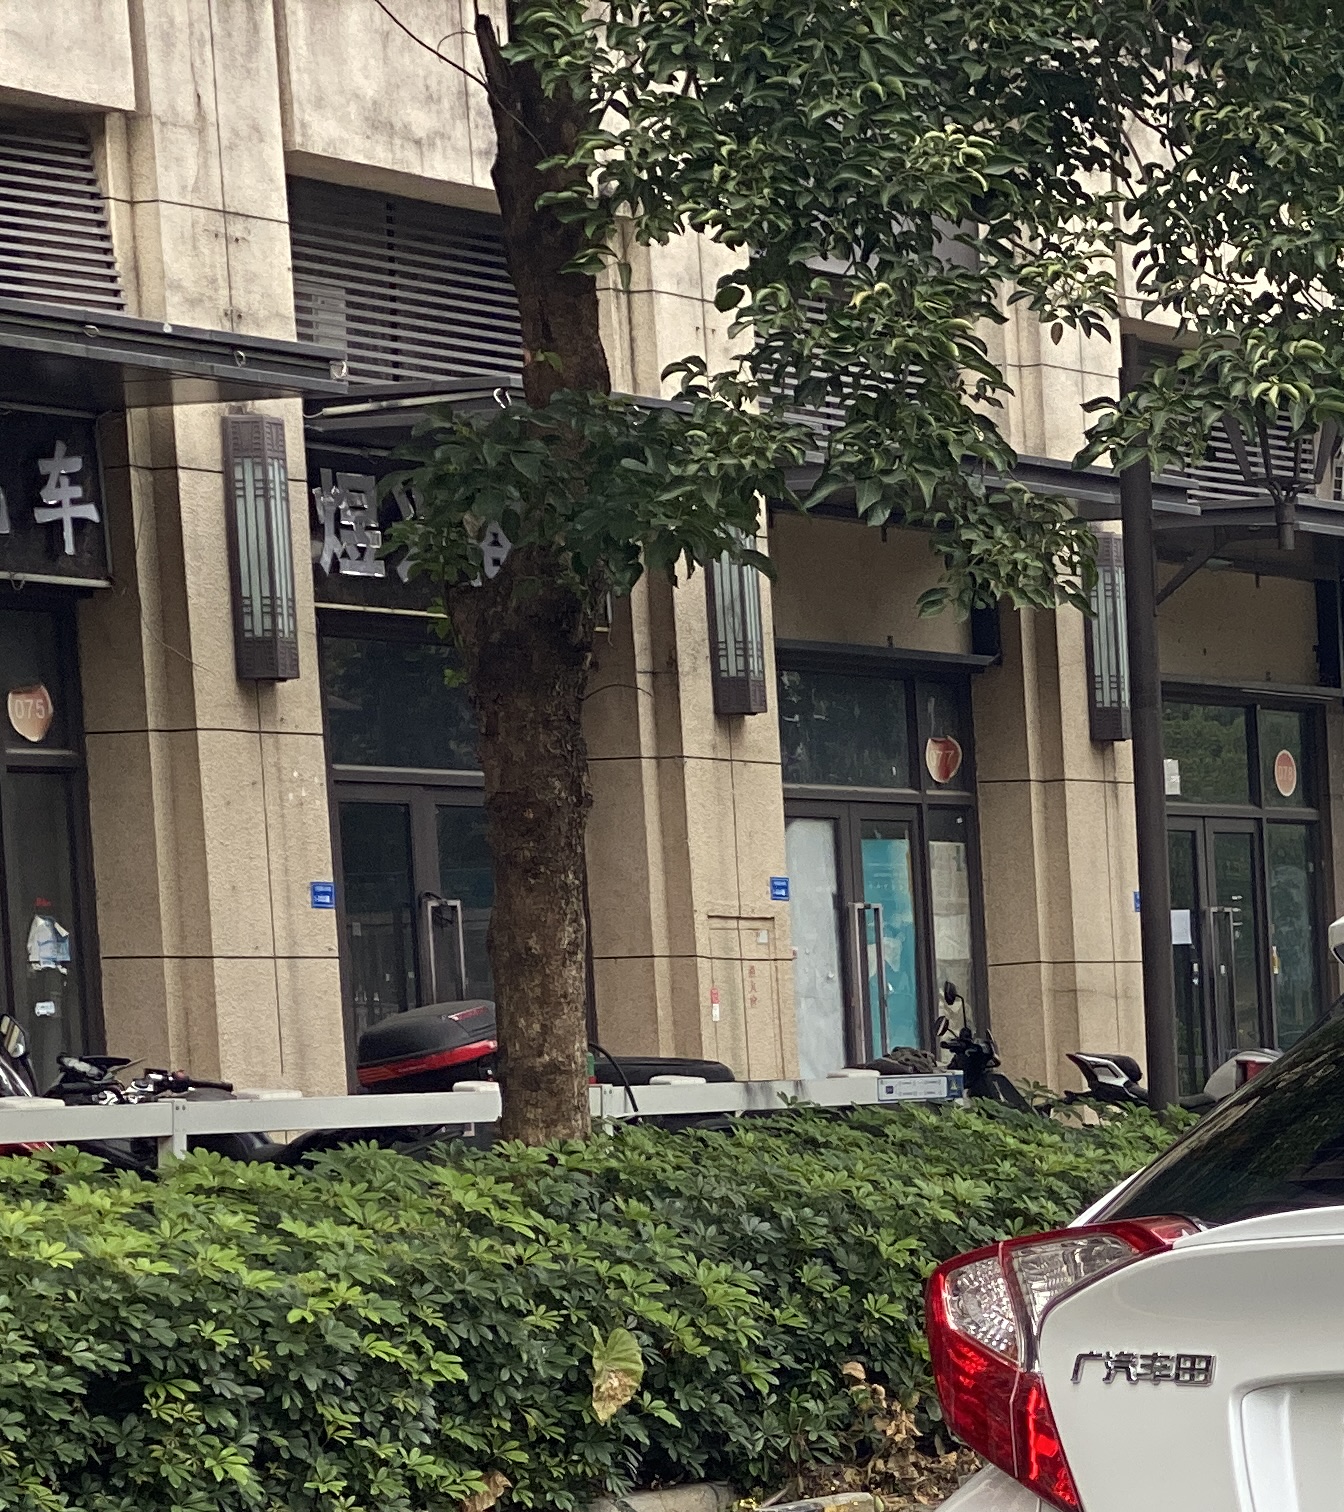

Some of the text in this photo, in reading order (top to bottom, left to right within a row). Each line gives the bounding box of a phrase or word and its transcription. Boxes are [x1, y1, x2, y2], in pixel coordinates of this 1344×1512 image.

[0, 440, 99, 556] 车
[14, 699, 46, 719] 075
[1070, 1350, 1217, 1388] 广汽丰田
